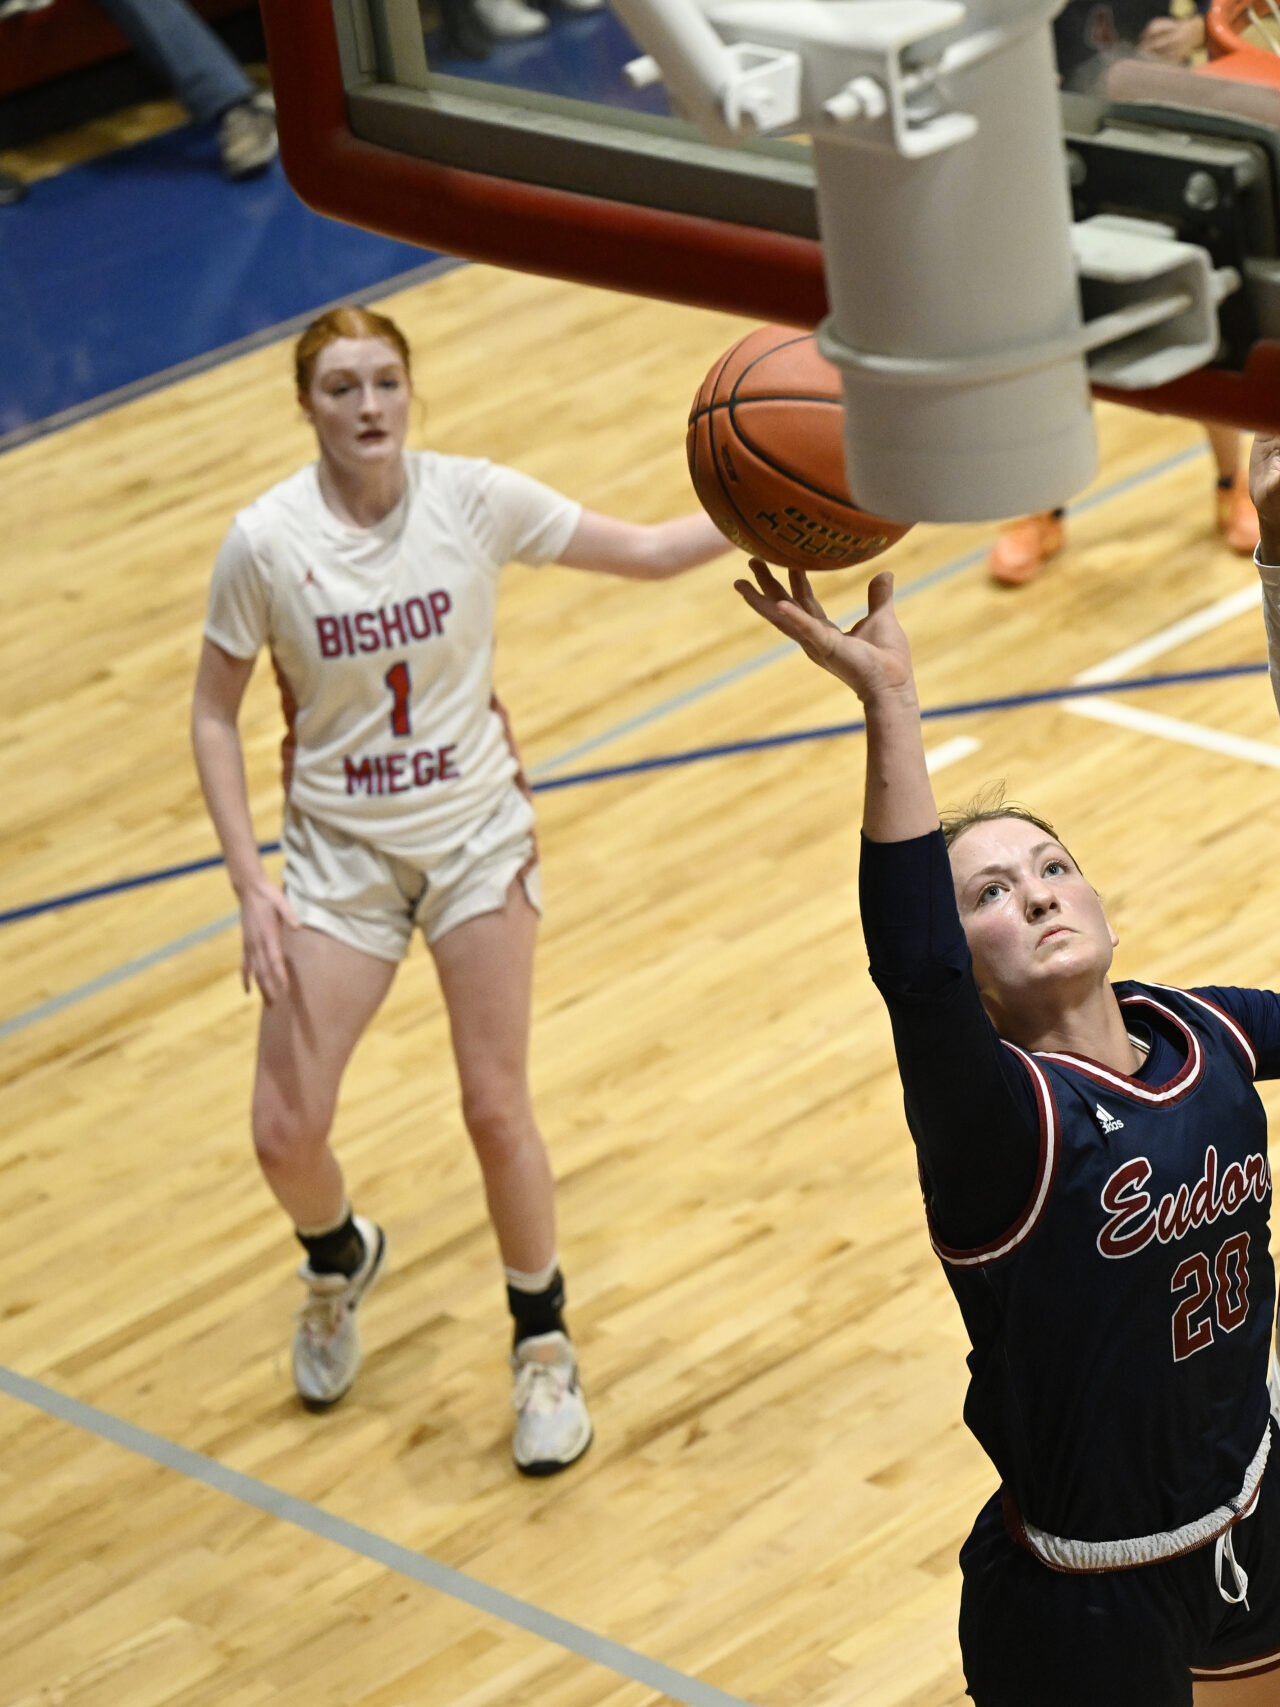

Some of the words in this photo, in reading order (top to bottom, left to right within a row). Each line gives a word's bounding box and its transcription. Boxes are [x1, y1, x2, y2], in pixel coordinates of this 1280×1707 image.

[316, 589, 452, 660] BISHOP
[384, 660, 411, 738] 1
[343, 744, 461, 796] MIEGE
[1096, 1144, 1272, 1260] Eudor
[1171, 1231, 1251, 1363] 20
